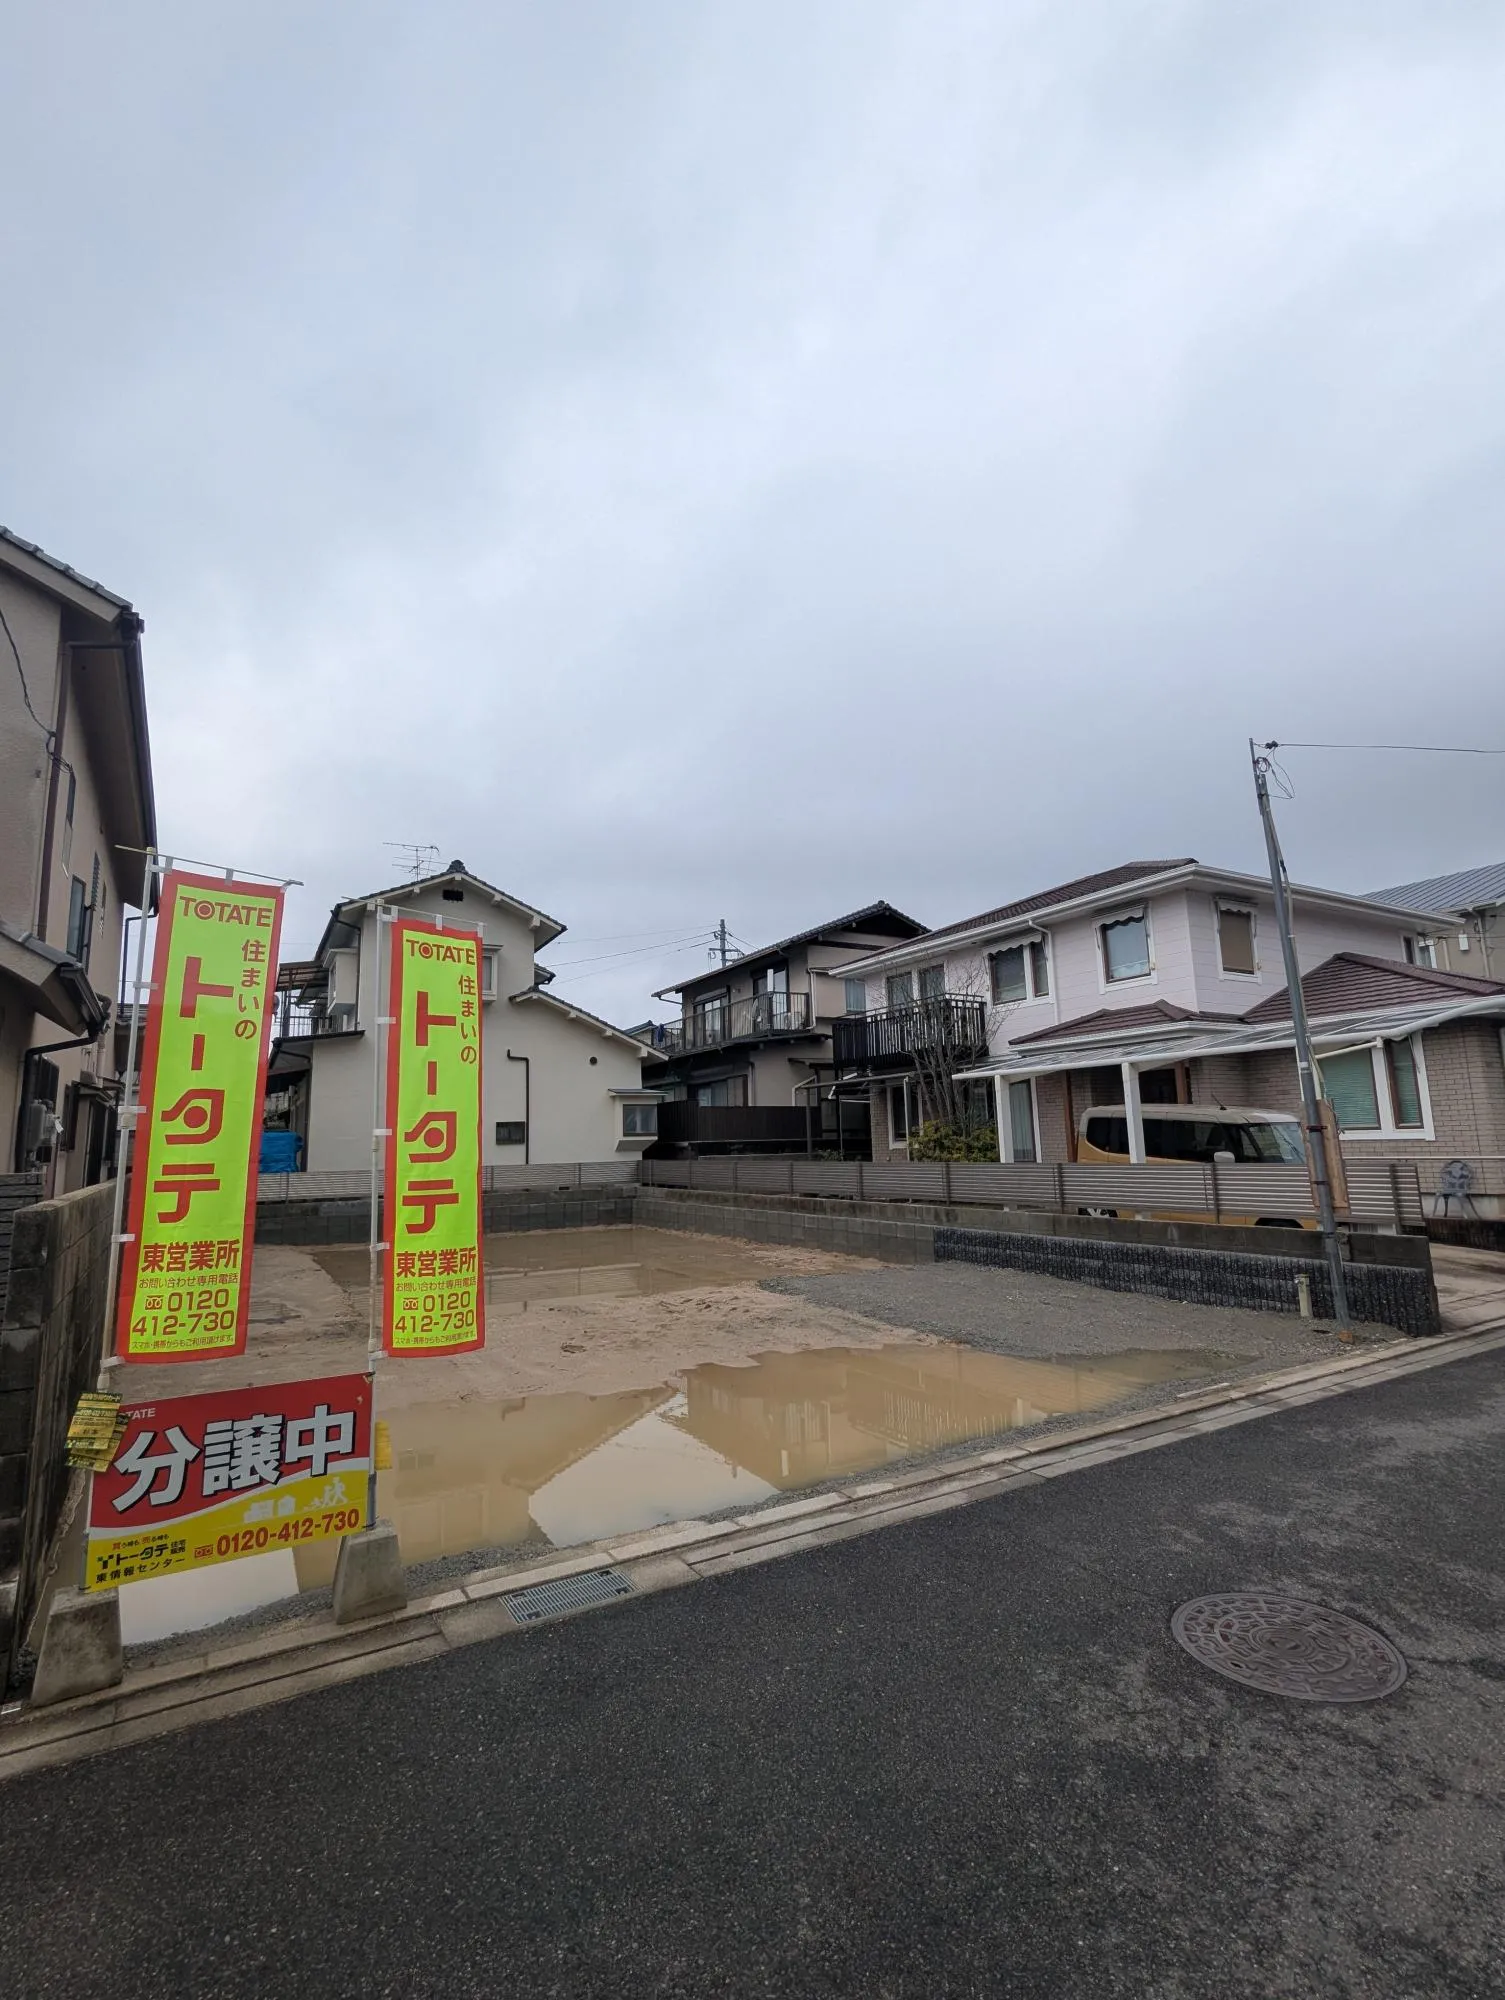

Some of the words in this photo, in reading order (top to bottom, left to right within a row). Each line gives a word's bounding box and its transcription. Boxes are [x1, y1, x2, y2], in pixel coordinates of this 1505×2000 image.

[180, 896, 273, 927] TOTATE
[406, 938, 475, 966] TOTATE
[235, 939, 266, 1040] 住まいの
[458, 975, 477, 1064] 住まいの
[154, 956, 234, 1223] トータテ
[402, 991, 459, 1234] トータテ
[141, 1239, 240, 1273] 東営業所
[396, 1246, 476, 1278] 東営業所
[140, 1273, 238, 1289] お問い合わせ専用電話
[168, 1288, 229, 1312] 0120
[423, 1291, 470, 1312] 0120
[132, 1310, 234, 1337] 412-730
[395, 1309, 474, 1333] 412-730
[112, 1404, 356, 1513] 分譲中
[217, 1508, 359, 1557] 0120-412-730
[96, 1558, 185, 1584] 東情報センター
